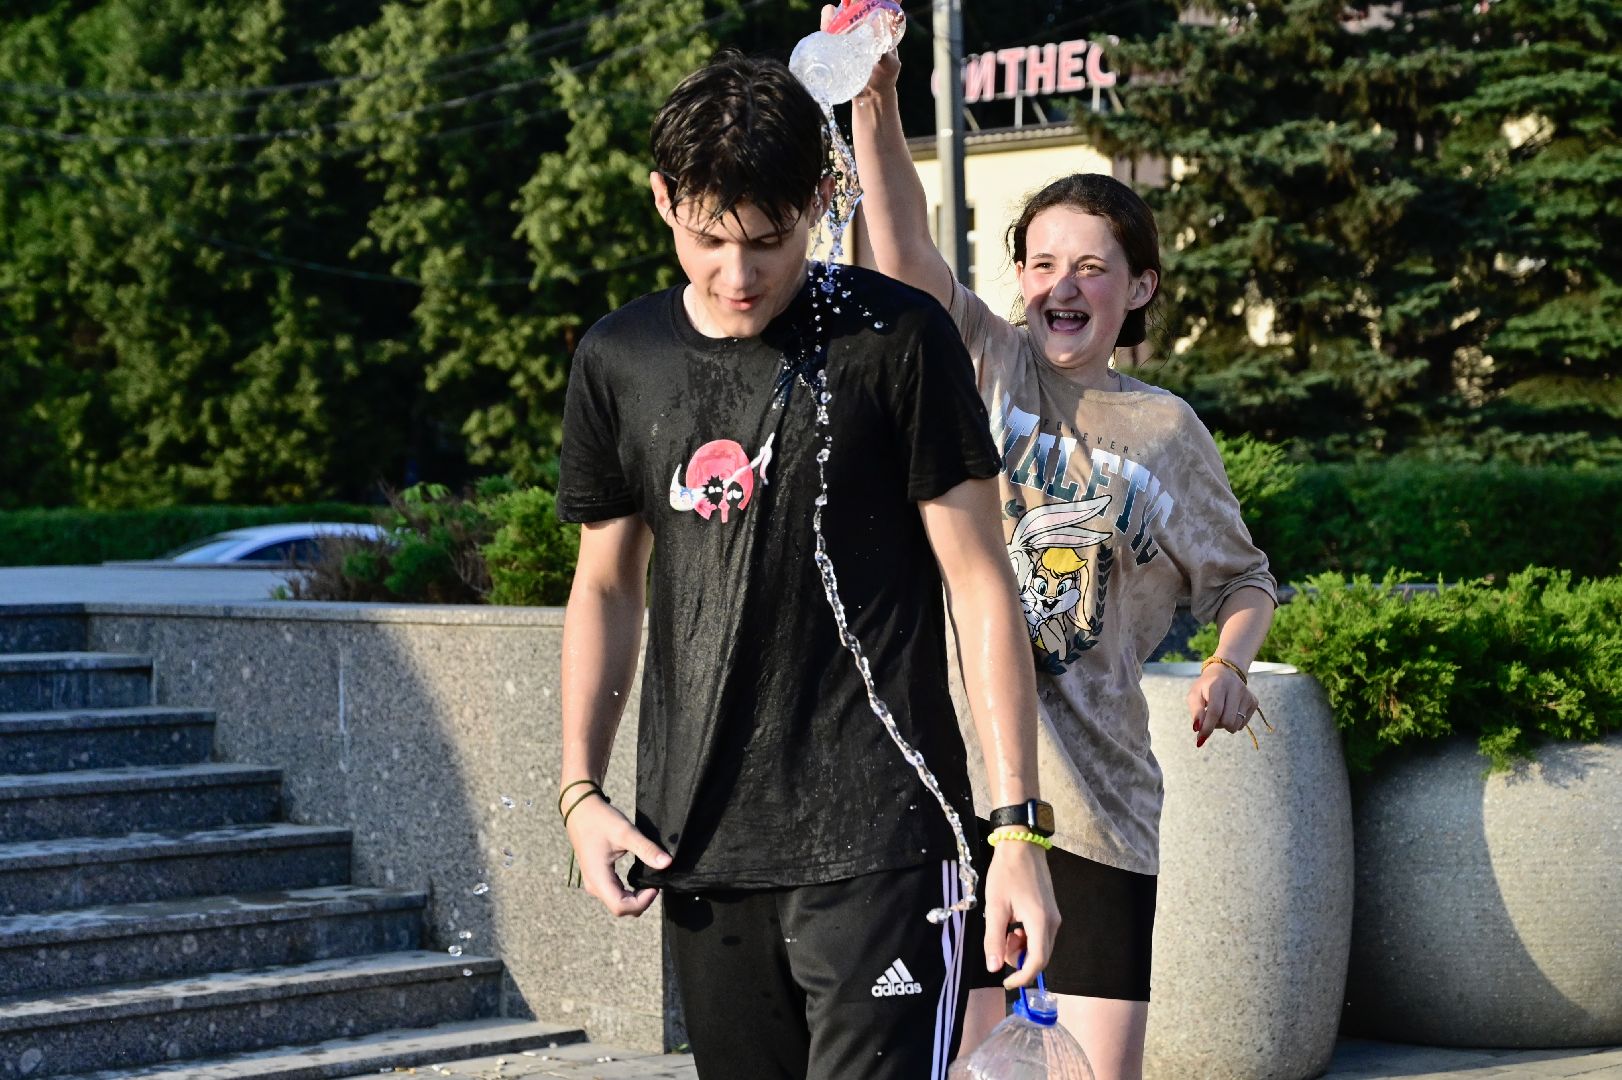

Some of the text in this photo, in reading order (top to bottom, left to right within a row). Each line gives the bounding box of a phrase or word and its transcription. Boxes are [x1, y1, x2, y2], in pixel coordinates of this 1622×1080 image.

[931, 35, 1118, 103] ИТНЕС
[1043, 419, 1129, 454] FOREVER
[871, 981, 922, 998] adidas
